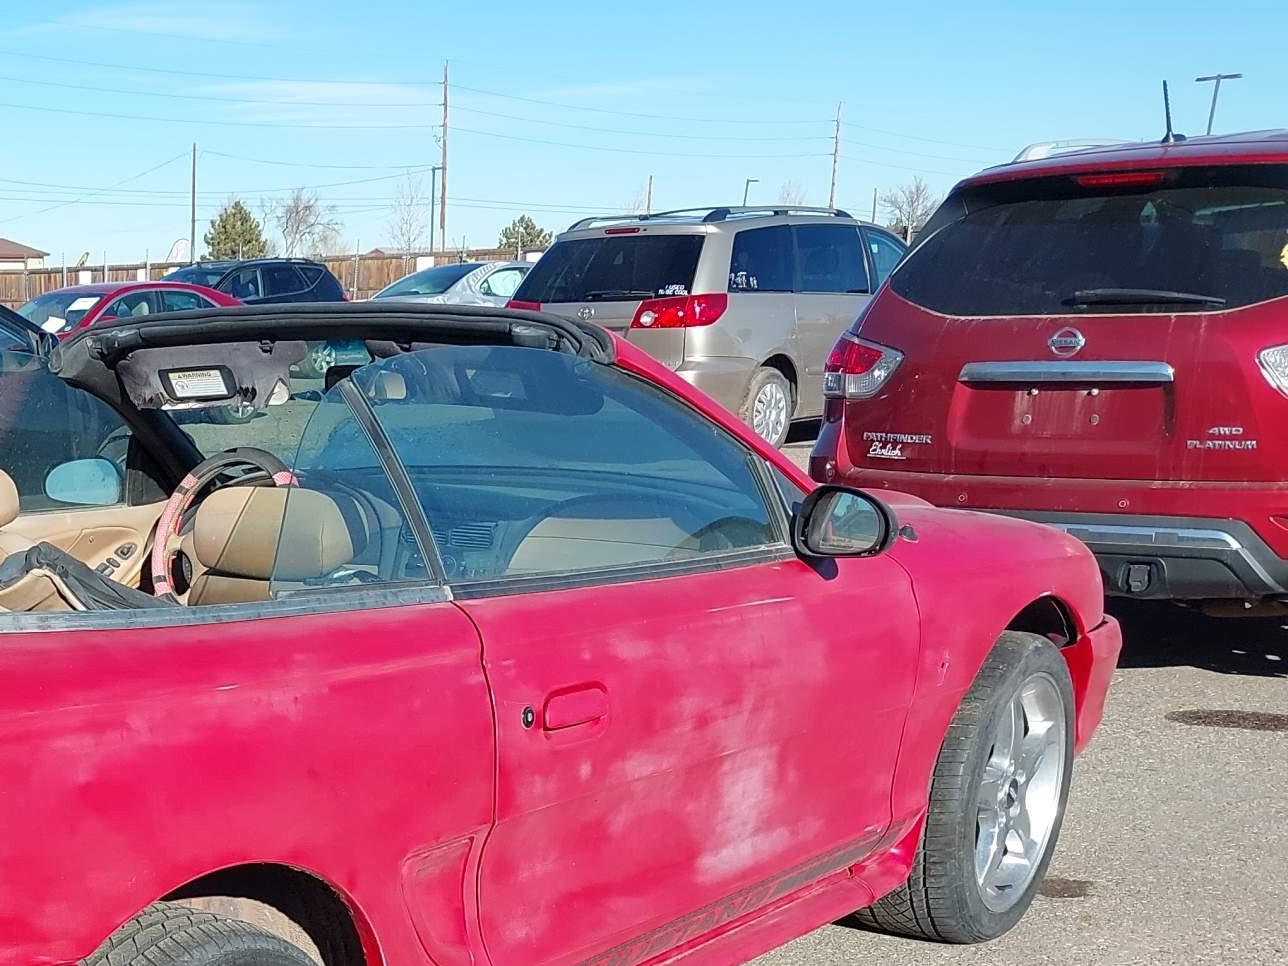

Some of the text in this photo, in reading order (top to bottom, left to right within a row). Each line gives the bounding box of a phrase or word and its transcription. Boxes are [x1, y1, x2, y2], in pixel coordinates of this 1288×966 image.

[1208, 427, 1243, 435] 4WD
[863, 432, 932, 444] PATHFINDER
[1187, 440, 1257, 449] PLATINUM
